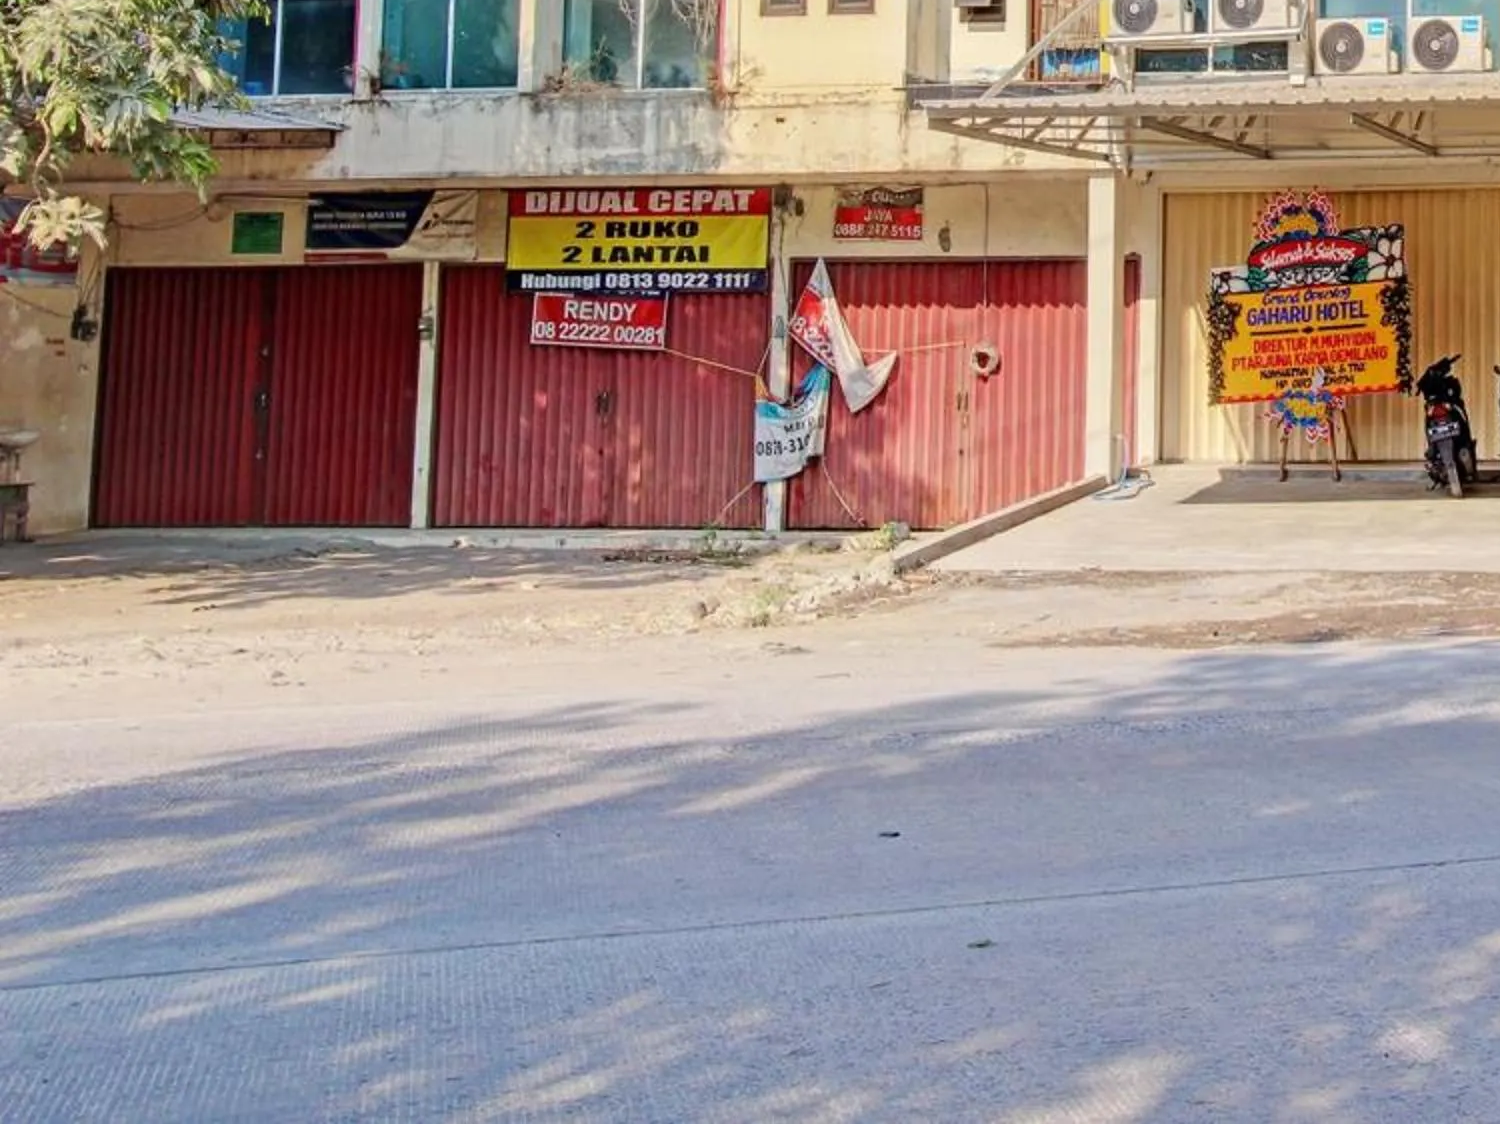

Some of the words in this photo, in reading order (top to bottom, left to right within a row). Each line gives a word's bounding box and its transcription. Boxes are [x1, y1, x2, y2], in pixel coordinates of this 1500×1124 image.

[525, 191, 640, 214] DIJUAL
[648, 189, 755, 213] CEPAT
[575, 221, 597, 239] 2
[605, 220, 699, 239] RUKO
[562, 247, 582, 263] 2
[591, 245, 710, 264] LANTAI
[521, 273, 601, 290] Hubungi
[605, 273, 653, 289] 0813
[658, 273, 709, 289] 9022
[713, 273, 751, 288] 1111
[564, 300, 637, 322] RENDY
[1247, 305, 1312, 327] GAHARU
[1316, 299, 1371, 320] HOTEL
[534, 321, 555, 339] 08
[559, 323, 610, 341] 22222
[613, 327, 666, 344] 00281
[1253, 337, 1307, 354] DIREKTUR
